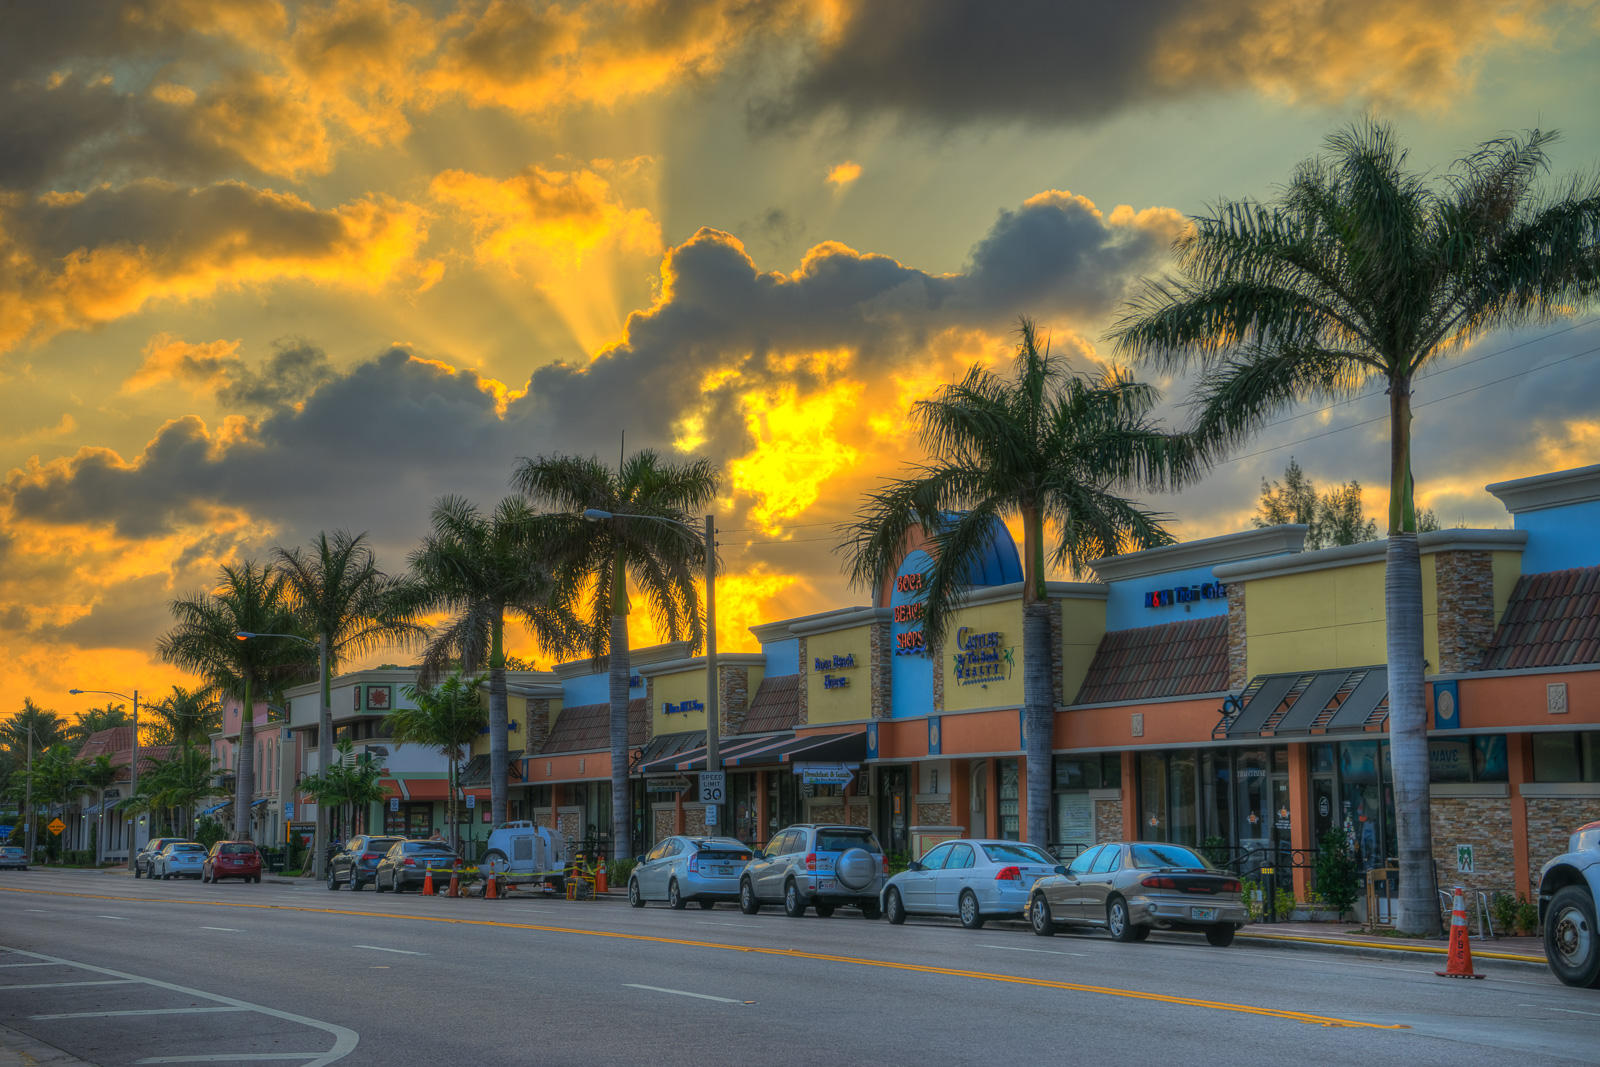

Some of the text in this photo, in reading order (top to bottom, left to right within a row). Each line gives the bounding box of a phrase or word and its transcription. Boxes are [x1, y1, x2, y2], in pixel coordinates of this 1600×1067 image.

[897, 573, 922, 592] BOCA
[1145, 590, 1171, 608] M&M
[896, 630, 923, 649] SHOPS
[957, 627, 999, 651] CASTLES
[957, 664, 999, 679] REALTY
[1431, 749, 1458, 762] WAVE
[703, 788, 722, 800] 30
